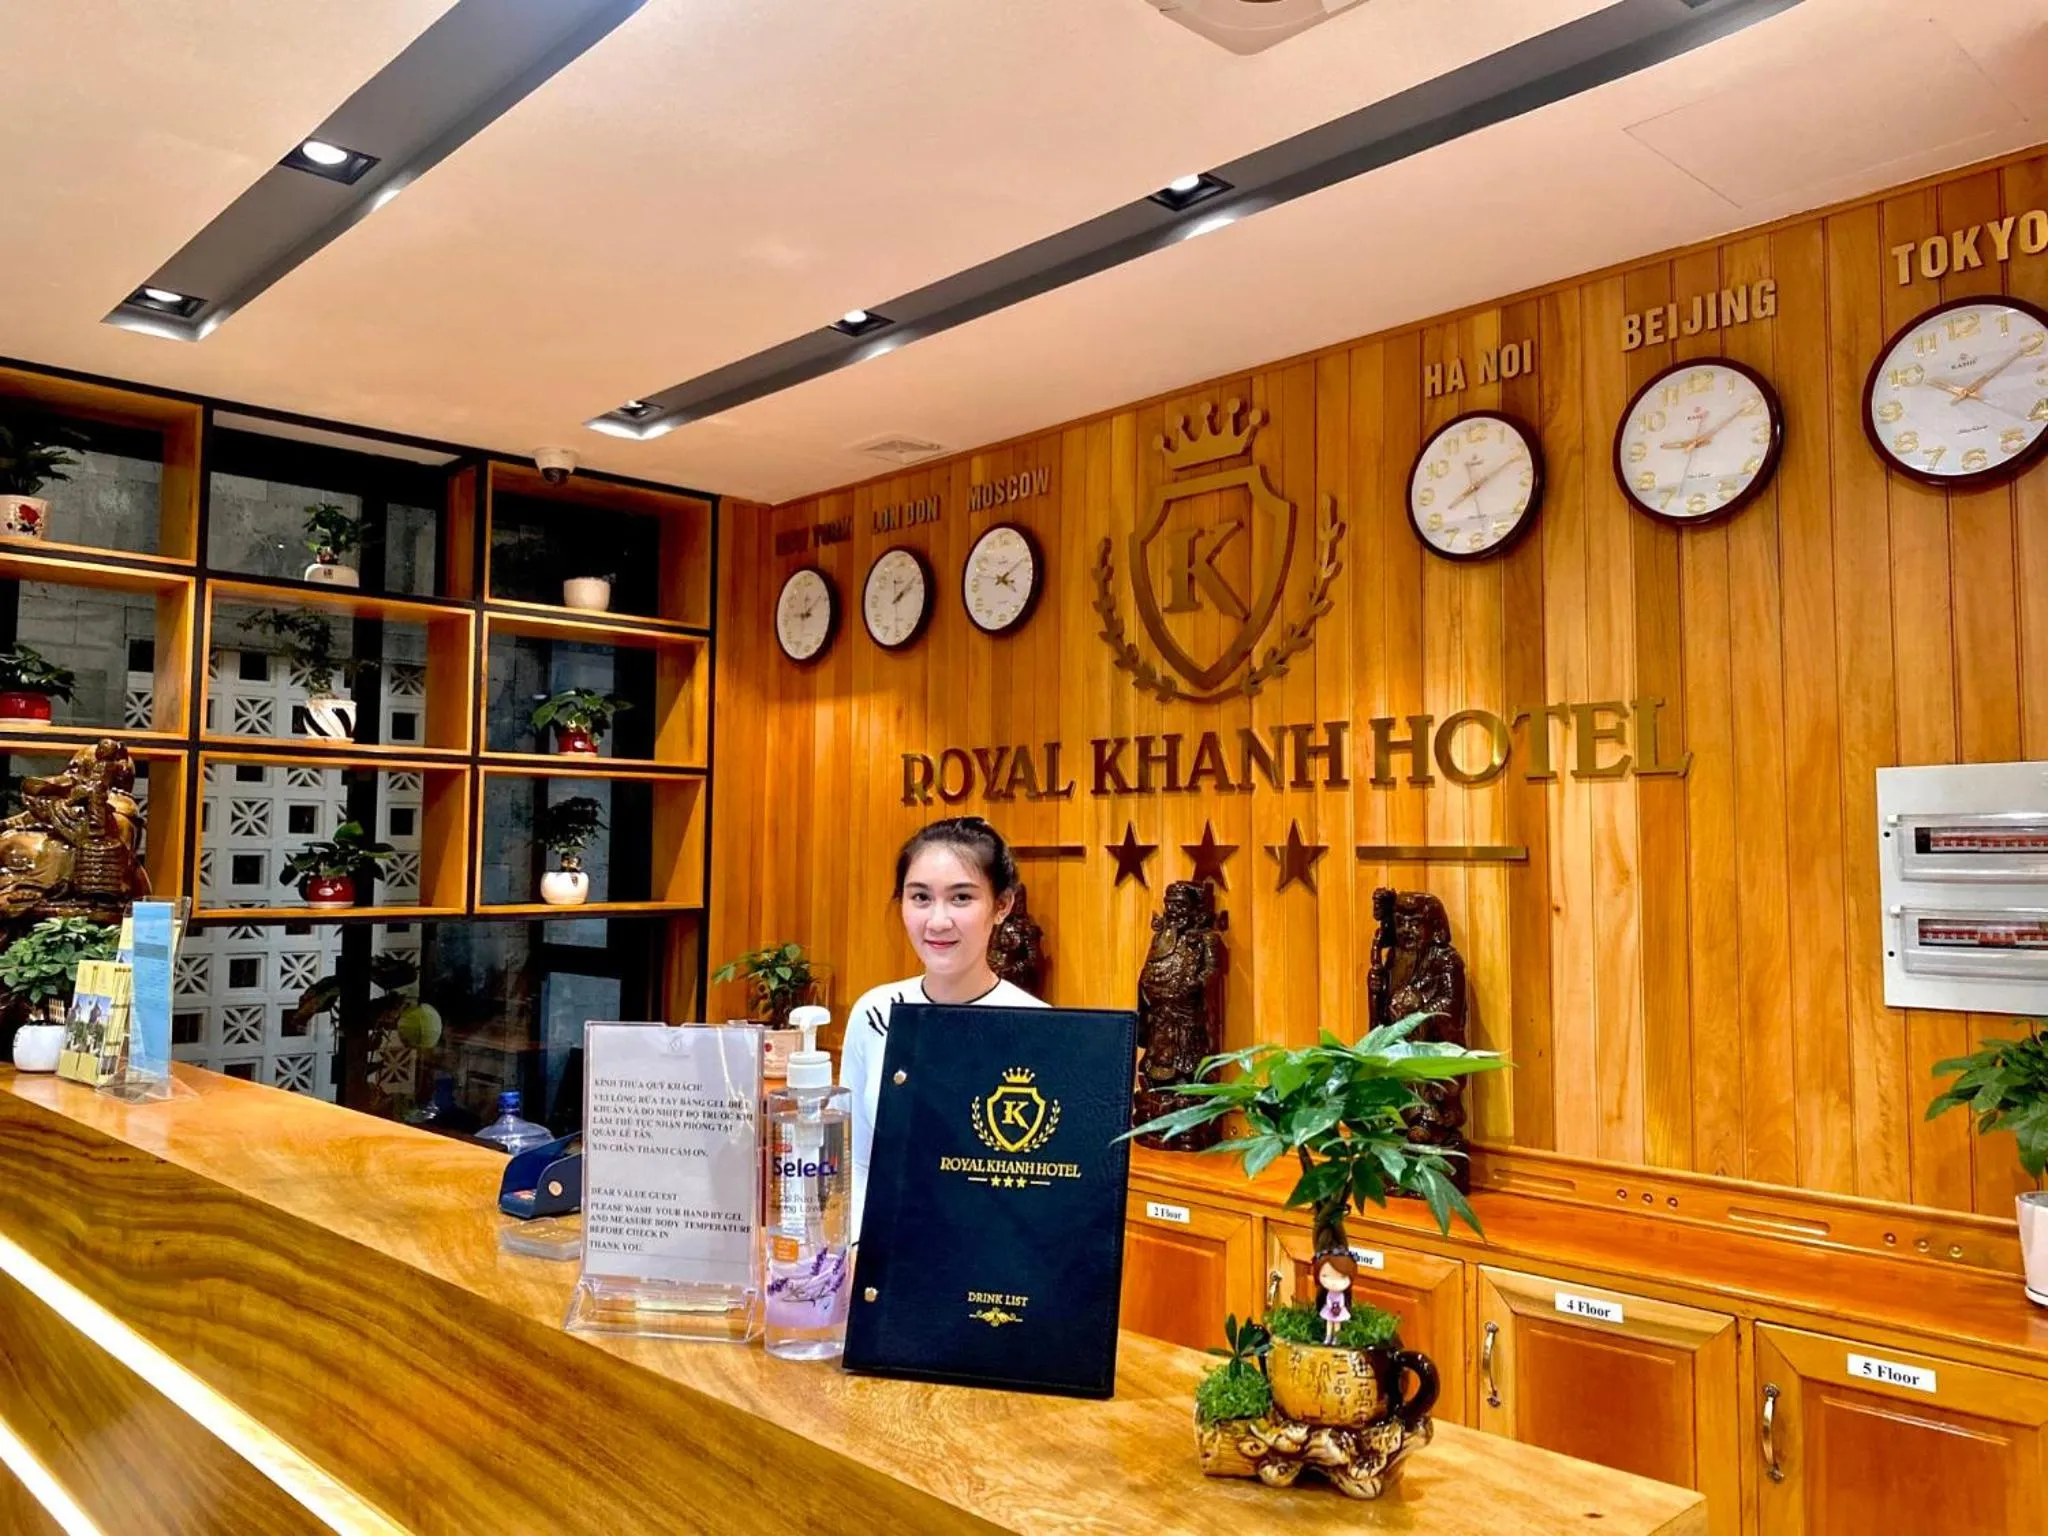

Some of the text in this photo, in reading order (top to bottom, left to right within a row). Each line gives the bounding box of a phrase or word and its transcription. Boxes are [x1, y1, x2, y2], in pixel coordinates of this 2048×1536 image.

[1892, 210, 2048, 284] TOKYO
[1622, 279, 1776, 352] BEIJING
[1943, 312, 1980, 340] 12
[1994, 314, 2011, 338] 1
[1912, 332, 1937, 357] 11
[2020, 330, 2044, 356] 2
[1424, 340, 1533, 397] HA NOI
[1888, 363, 1925, 391] 10
[1878, 400, 1903, 424] 9
[1894, 431, 1919, 454] 8
[2000, 429, 2026, 453] 5
[1922, 445, 1947, 471] 7
[1961, 447, 1987, 473] 6
[967, 468, 1049, 511] MOSCOW
[1163, 519, 1250, 622] K
[901, 697, 1694, 806] ROYAL KHANH HOTEL
[1001, 1100, 1030, 1130] K
[940, 1157, 1082, 1178] ROYAL KHANH HOTEL
[591, 1187, 615, 1196] DEAR
[617, 1188, 646, 1198] VALUE
[590, 1202, 743, 1221] PLEASE WASH YOUR HAND BY GEL
[590, 1214, 751, 1234] AND MEASURE BODY TEMPERATURE
[1161, 1207, 1183, 1220] Floor
[589, 1225, 624, 1235] BEFORE
[626, 1227, 658, 1238] CHECK
[590, 1239, 620, 1250] THANK
[968, 1291, 1028, 1307] DRINK LIST
[1566, 1299, 1611, 1318] 4 Floor
[1863, 1361, 1921, 1387] 5 Floor
